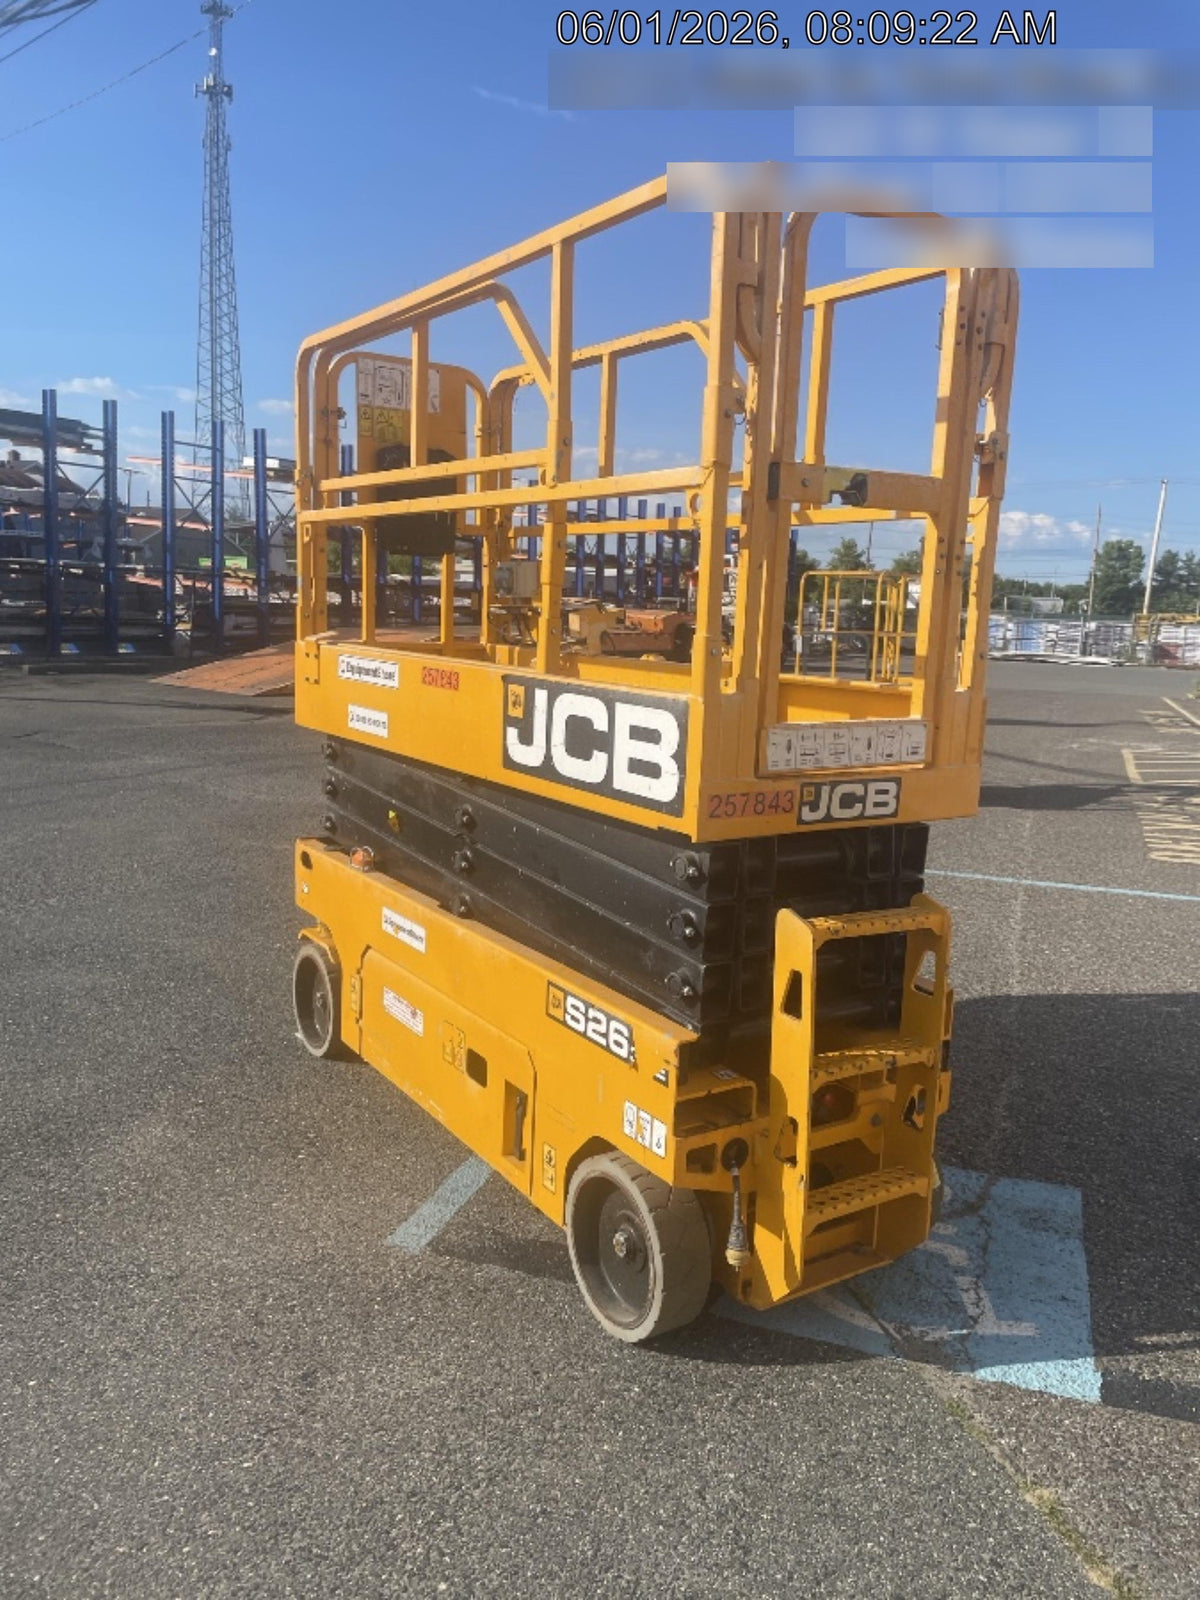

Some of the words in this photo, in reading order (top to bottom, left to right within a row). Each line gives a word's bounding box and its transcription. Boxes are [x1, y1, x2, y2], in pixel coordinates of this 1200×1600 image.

[506, 687, 680, 802] JCB
[709, 791, 795, 818] 257843
[801, 782, 898, 821] JCB
